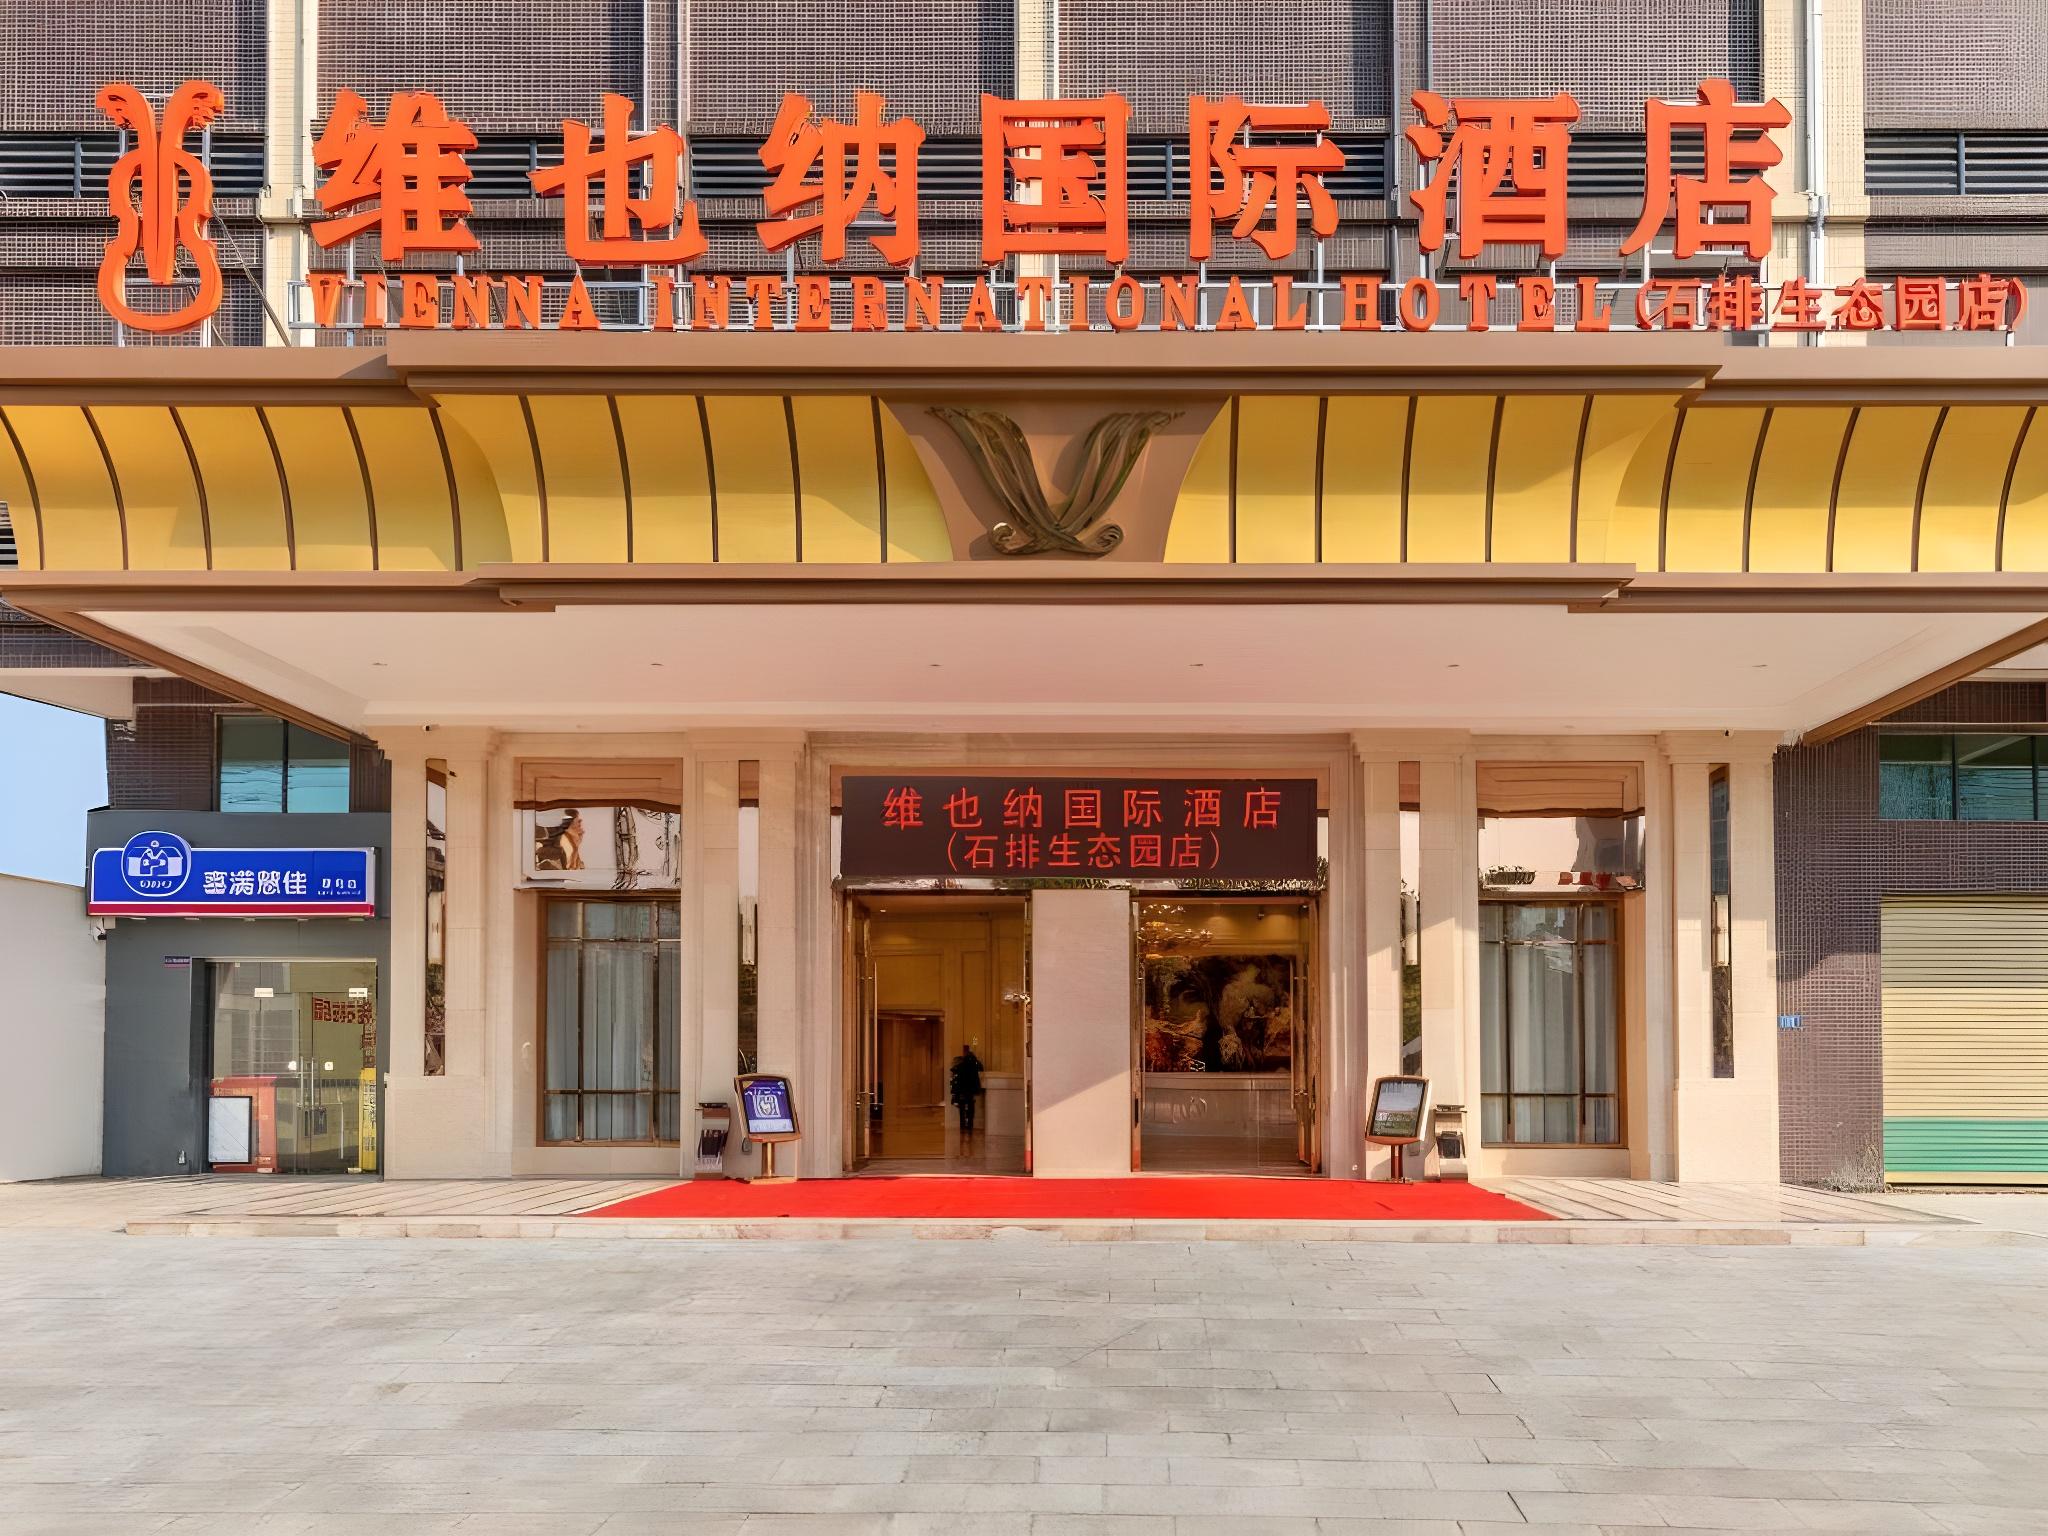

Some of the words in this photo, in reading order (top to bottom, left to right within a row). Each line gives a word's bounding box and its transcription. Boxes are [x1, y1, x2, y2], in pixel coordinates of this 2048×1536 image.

[312, 80, 1789, 266] 维也纳国际酒店
[307, 273, 601, 330] VIENNA
[651, 273, 1307, 331] INTERNATIONAL
[1340, 275, 1611, 332] HOTEL
[1636, 272, 2029, 332] (石排生态园店)
[882, 786, 1281, 830] 维也纳国际酒店
[946, 832, 1221, 871] (石排生态园店)
